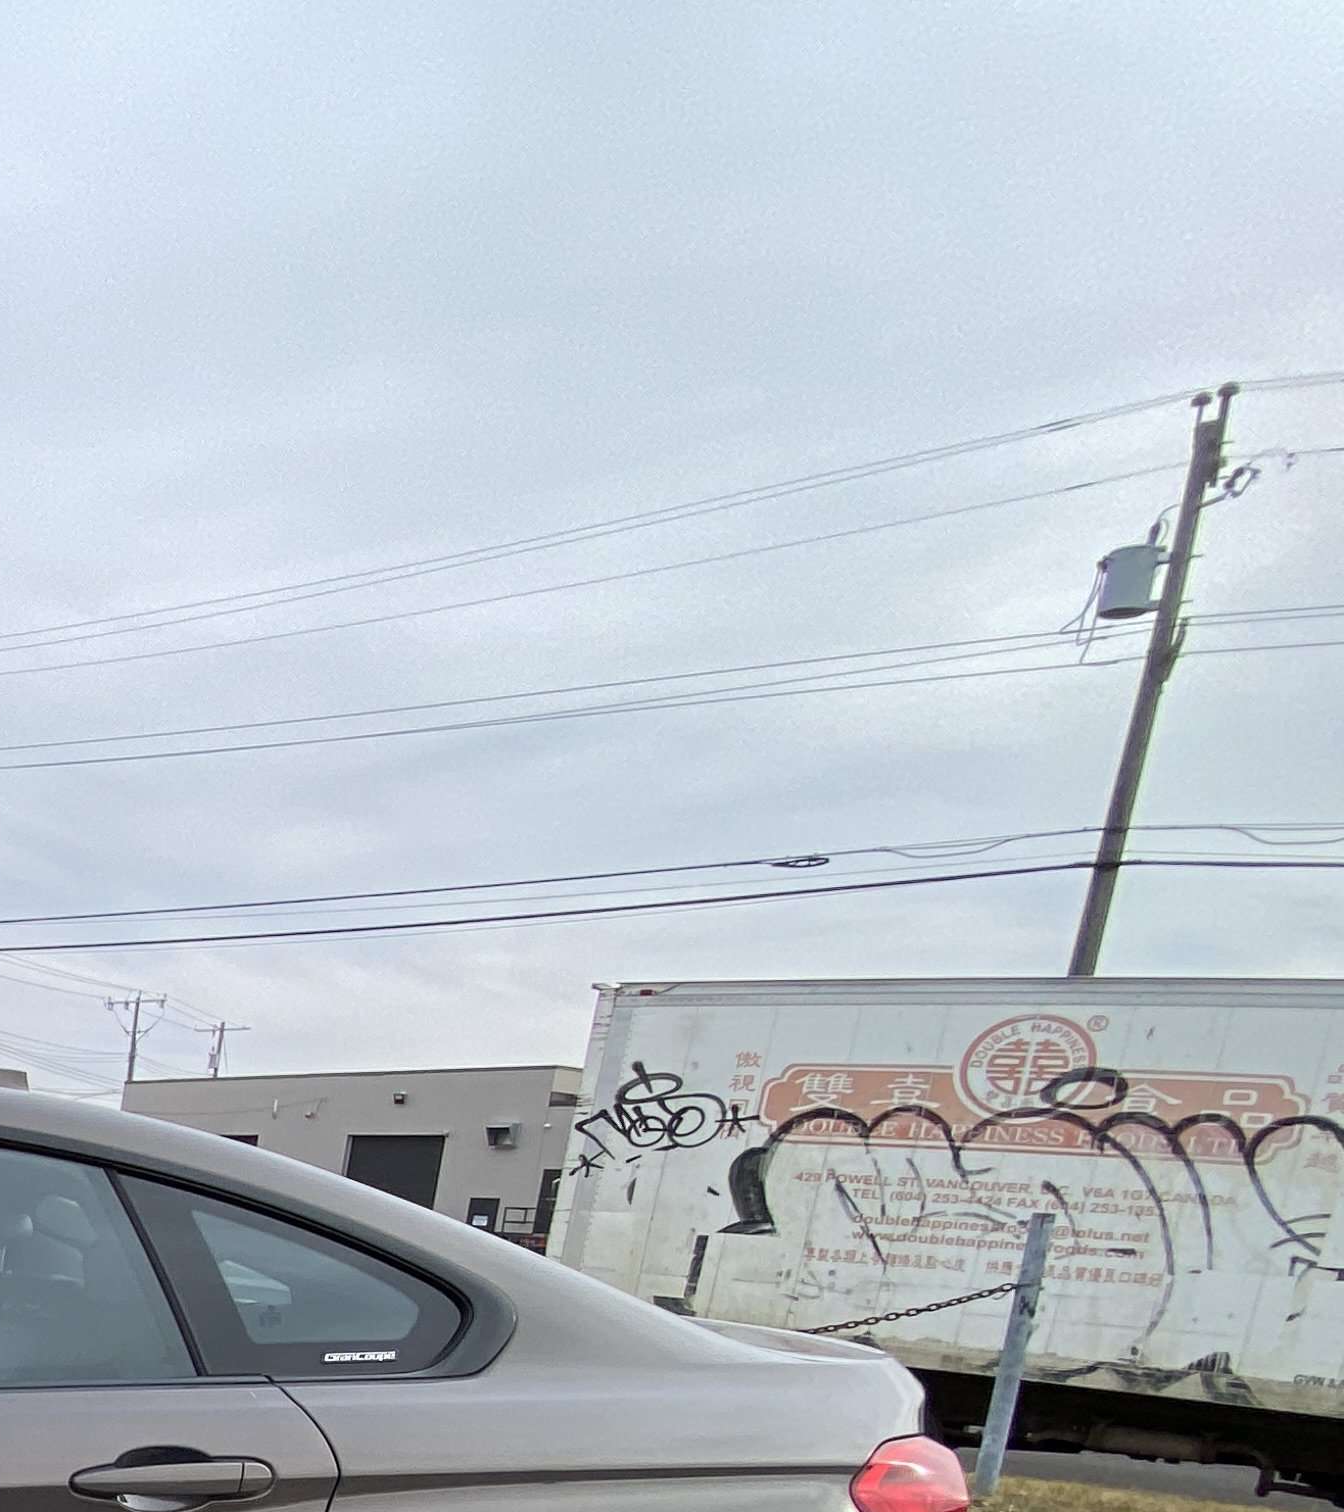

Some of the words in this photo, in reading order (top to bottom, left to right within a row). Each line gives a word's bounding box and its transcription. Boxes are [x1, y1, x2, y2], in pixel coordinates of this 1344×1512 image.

[970, 1024, 1022, 1069] DOUBLE
[796, 1116, 896, 1137] OUBE
[1044, 1199, 1086, 1215] (64)
